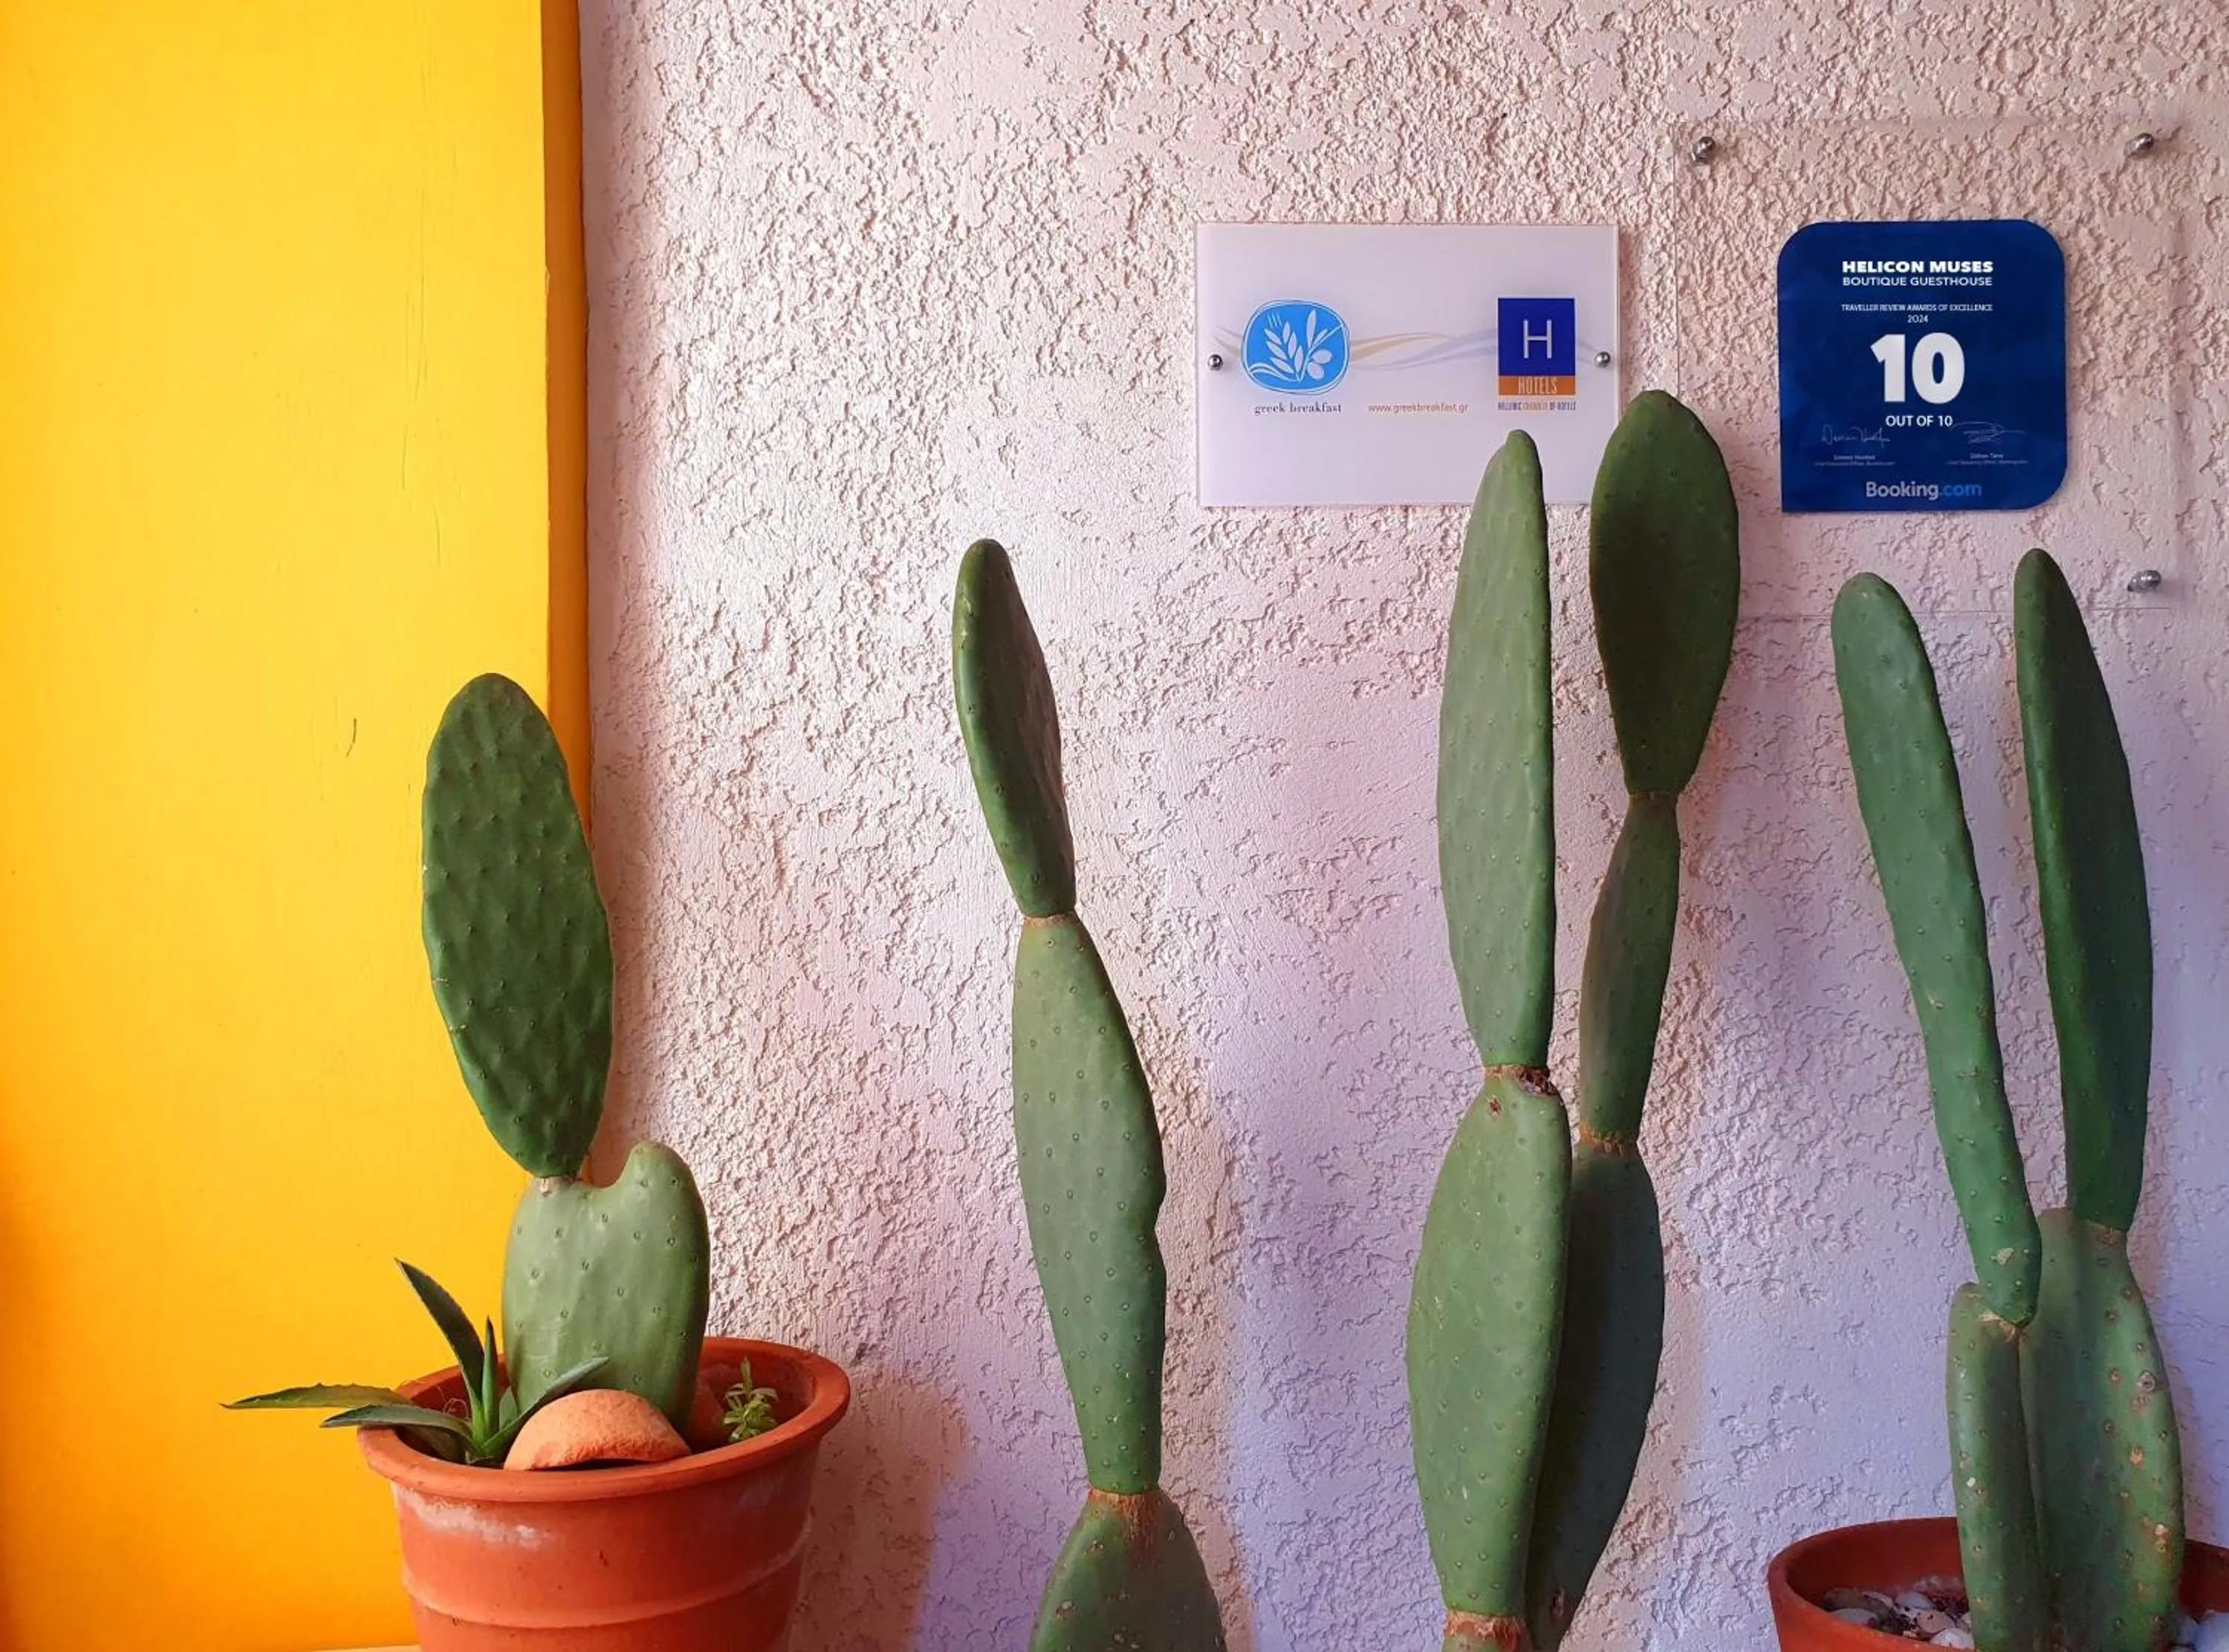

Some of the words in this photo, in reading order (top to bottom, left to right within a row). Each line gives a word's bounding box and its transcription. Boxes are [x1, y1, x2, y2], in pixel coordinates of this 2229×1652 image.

[1842, 261, 1924, 273] HELICON
[1930, 261, 1993, 273] MUSES
[1842, 277, 1907, 287] BOUTIQUE
[1910, 277, 1993, 286] GUESTHOUSE
[1907, 314, 1929, 323] 2024
[1523, 319, 1552, 359] H
[1870, 332, 1965, 404] 10
[1517, 377, 1557, 394] HOTELS
[1254, 402, 1285, 415] greek
[1289, 401, 1342, 413] breakfast
[1367, 402, 1469, 414] www.greekbreakfast.gr
[1885, 415, 1913, 426] OUT
[1916, 415, 1934, 426] OF
[1938, 415, 1953, 426] 10
[1866, 481, 1982, 501] Booking.com
